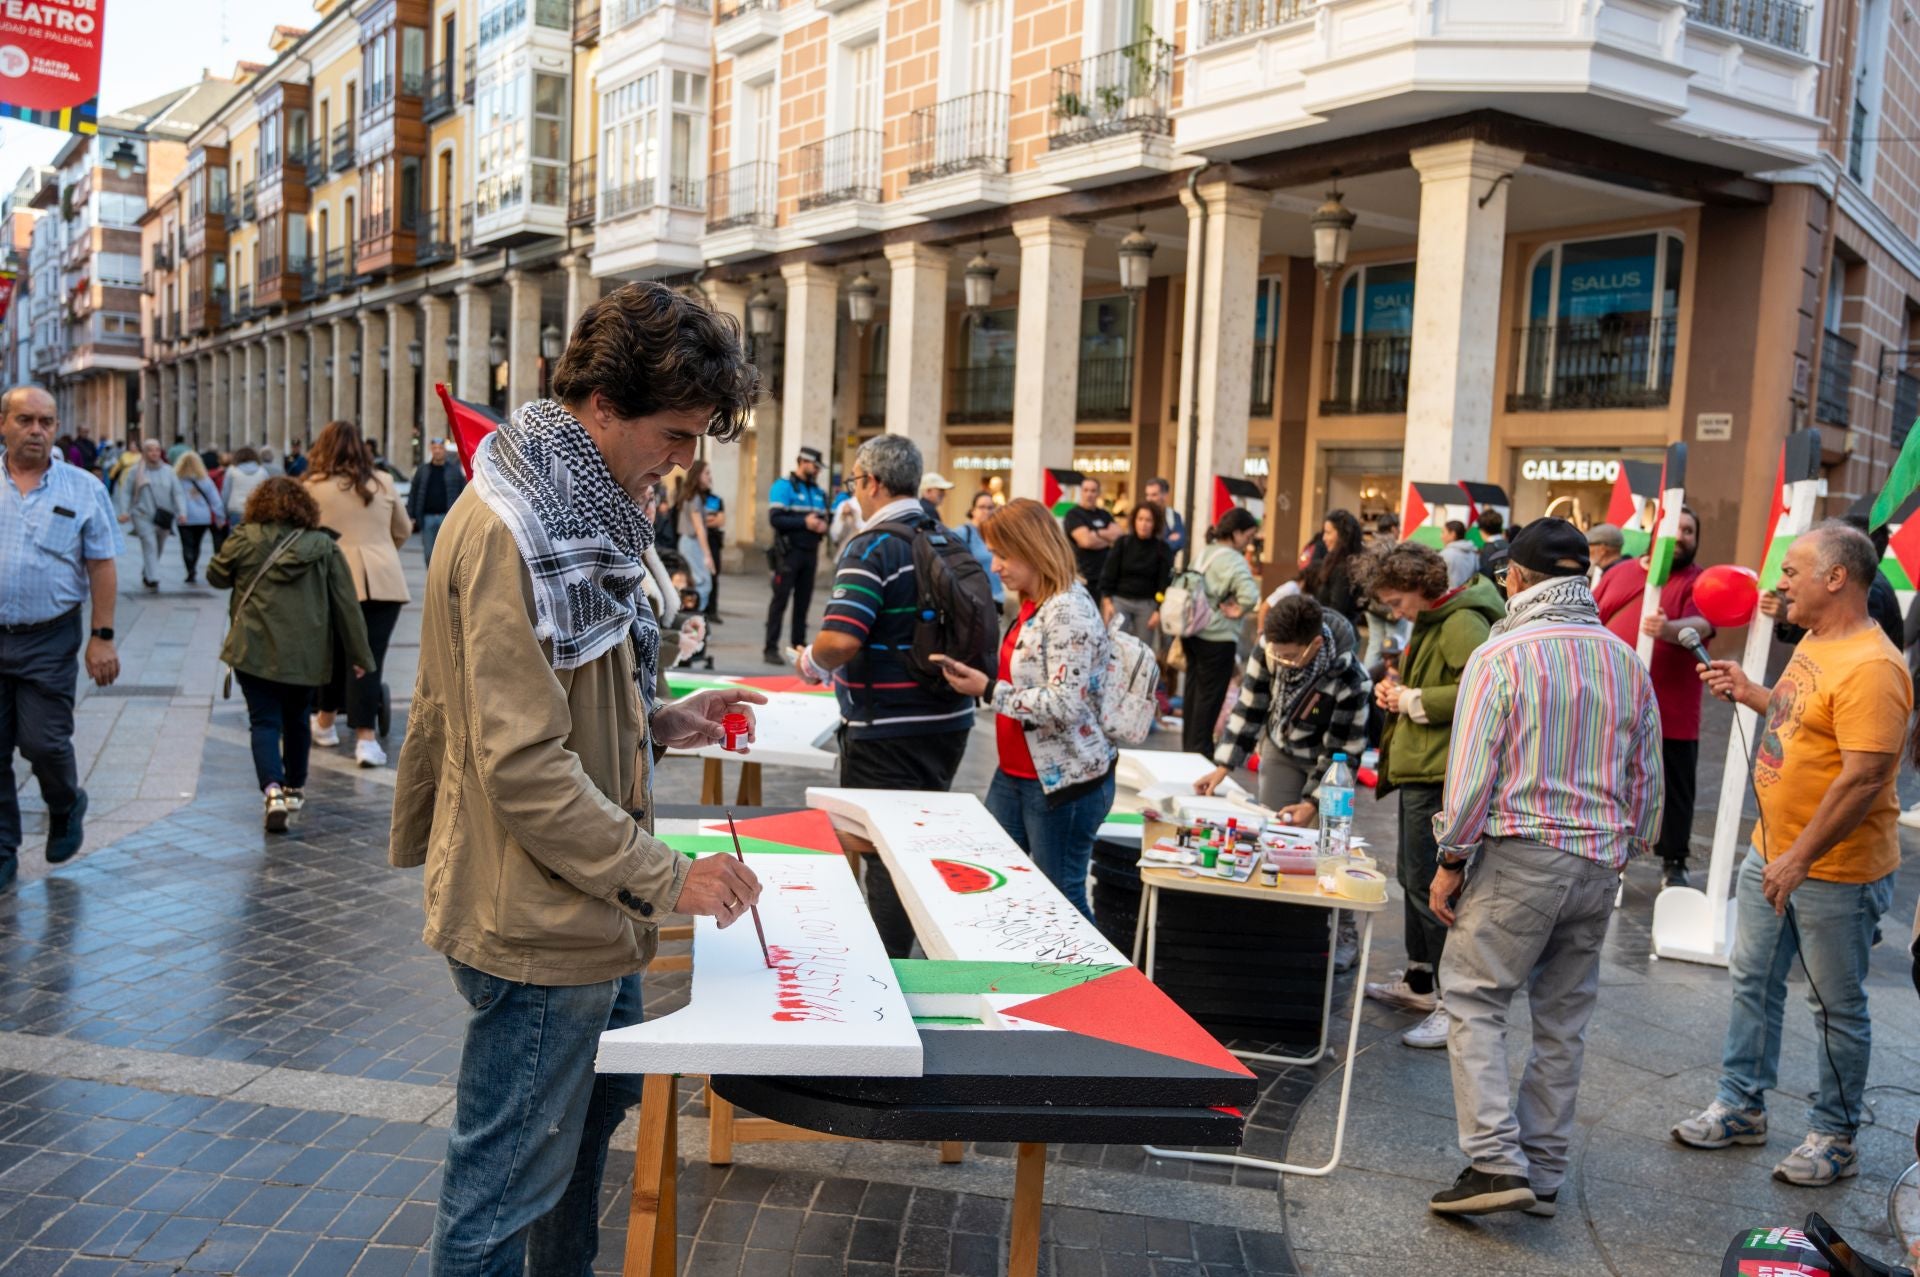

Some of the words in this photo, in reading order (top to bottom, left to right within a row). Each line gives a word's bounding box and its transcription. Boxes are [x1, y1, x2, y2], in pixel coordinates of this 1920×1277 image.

[28, 26, 42, 38] DE
[44, 29, 94, 48] PALENCIA
[31, 65, 80, 82] PRINCIPAL
[32, 56, 70, 72] TEATRO
[1571, 271, 1641, 293] SALUS
[1243, 458, 1270, 476] NIA
[1521, 459, 1621, 484] CALZEDO
